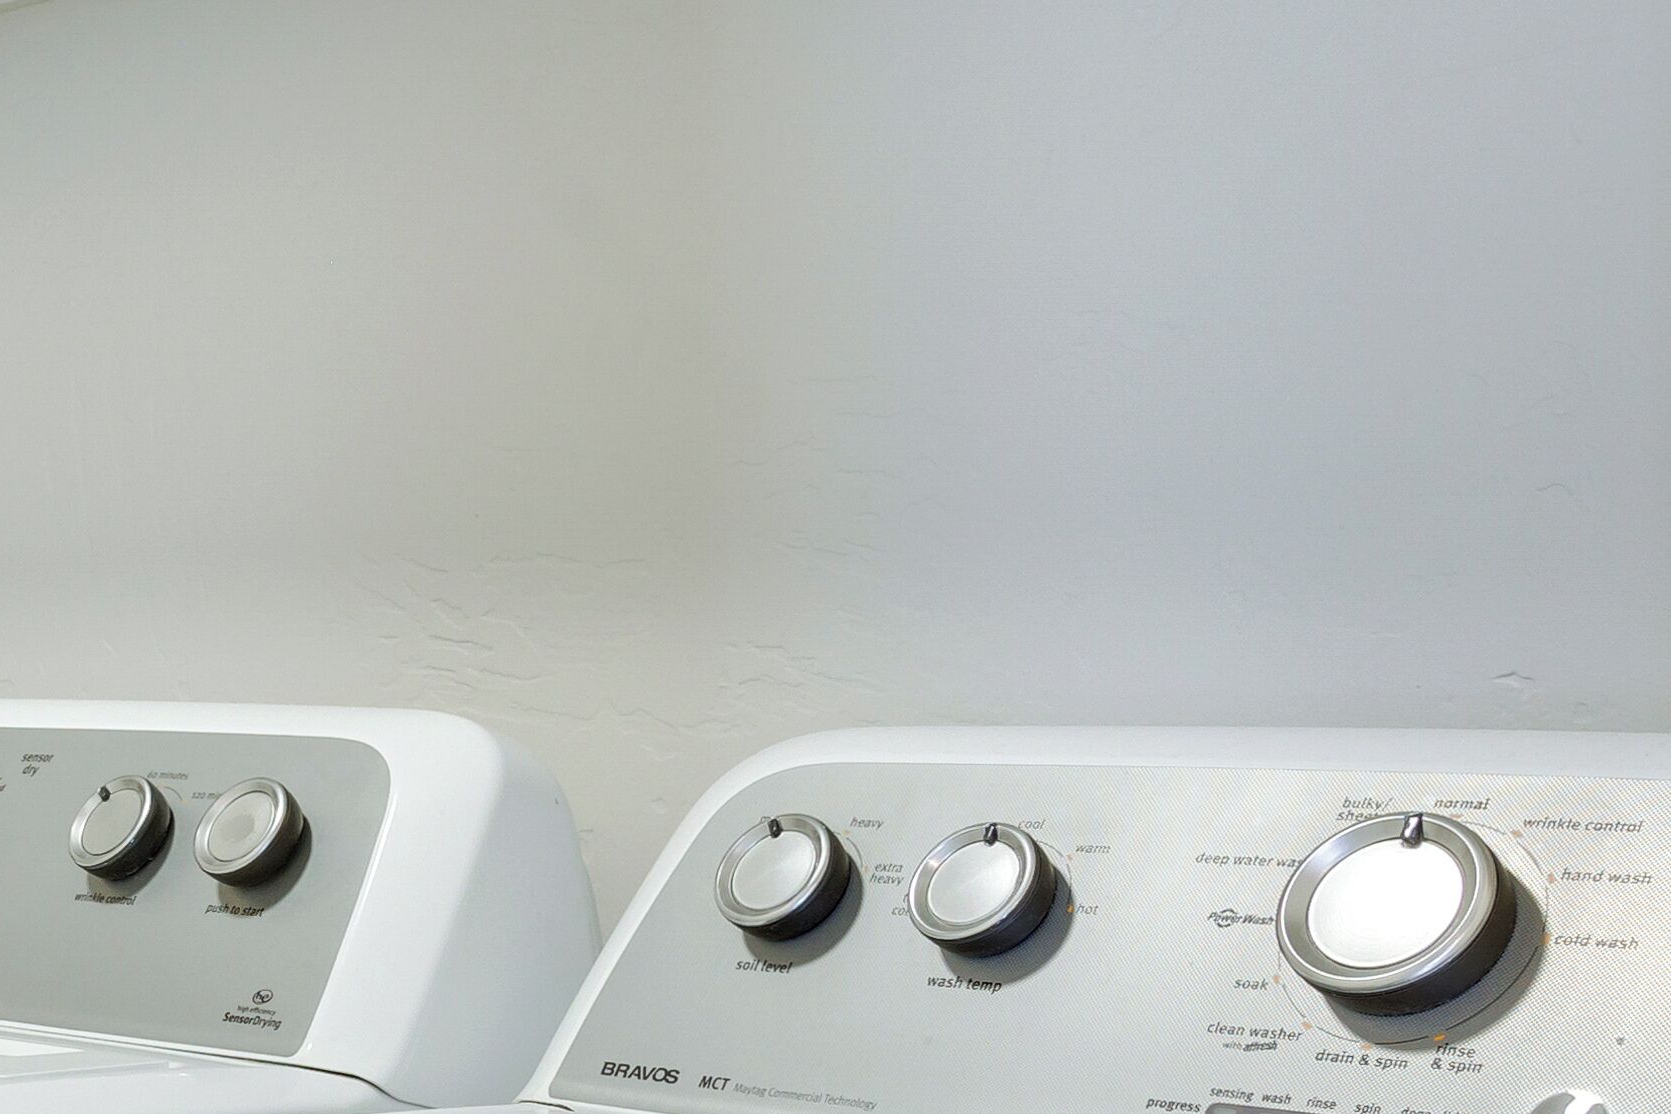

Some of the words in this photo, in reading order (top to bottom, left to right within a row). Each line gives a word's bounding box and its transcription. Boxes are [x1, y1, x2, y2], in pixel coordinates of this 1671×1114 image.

[20, 753, 55, 763] sensor
[22, 763, 41, 777] dry
[1341, 796, 1393, 811] bulky/
[1434, 798, 1490, 810] normal
[850, 816, 885, 831] heavy
[1523, 816, 1581, 831] wrinkle
[1585, 821, 1643, 833] control
[1075, 844, 1112, 854] warm
[875, 862, 904, 873] extra
[1195, 854, 1230, 867] deep
[1233, 854, 1272, 867] water
[1276, 858, 1304, 868] was
[870, 872, 905, 886] heavy
[1560, 866, 1605, 883] hand
[1608, 872, 1654, 885] wash
[75, 893, 105, 904] wrinkle
[106, 895, 137, 906] control
[204, 903, 230, 914] push
[230, 905, 240, 915] to
[241, 906, 265, 917] start
[1076, 902, 1099, 916] hot
[1554, 934, 1591, 947] cold
[1595, 936, 1639, 950] wash
[735, 959, 759, 972] soil
[760, 960, 793, 974] level
[927, 976, 962, 990] wash
[965, 978, 1003, 995] temp
[1233, 977, 1269, 991] soak
[222, 1012, 282, 1030] SensorDrying
[1207, 1022, 1245, 1037] clean
[1249, 1026, 1303, 1042] washer
[1435, 1044, 1477, 1059] rinse
[1315, 1050, 1355, 1065] drain
[1358, 1054, 1371, 1066] &
[1375, 1056, 1410, 1071] spin
[1430, 1058, 1443, 1071] &
[1447, 1060, 1483, 1074] spin
[601, 1061, 680, 1084] BRAVOS
[698, 1075, 731, 1092] MCT
[733, 1083, 767, 1098] Maytag
[768, 1087, 822, 1104] Commercial
[823, 1094, 878, 1112] Technology
[1210, 1086, 1255, 1102] sensing
[1261, 1091, 1292, 1105] wash
[1306, 1096, 1338, 1110] rinse
[1146, 1098, 1202, 1114] progress
